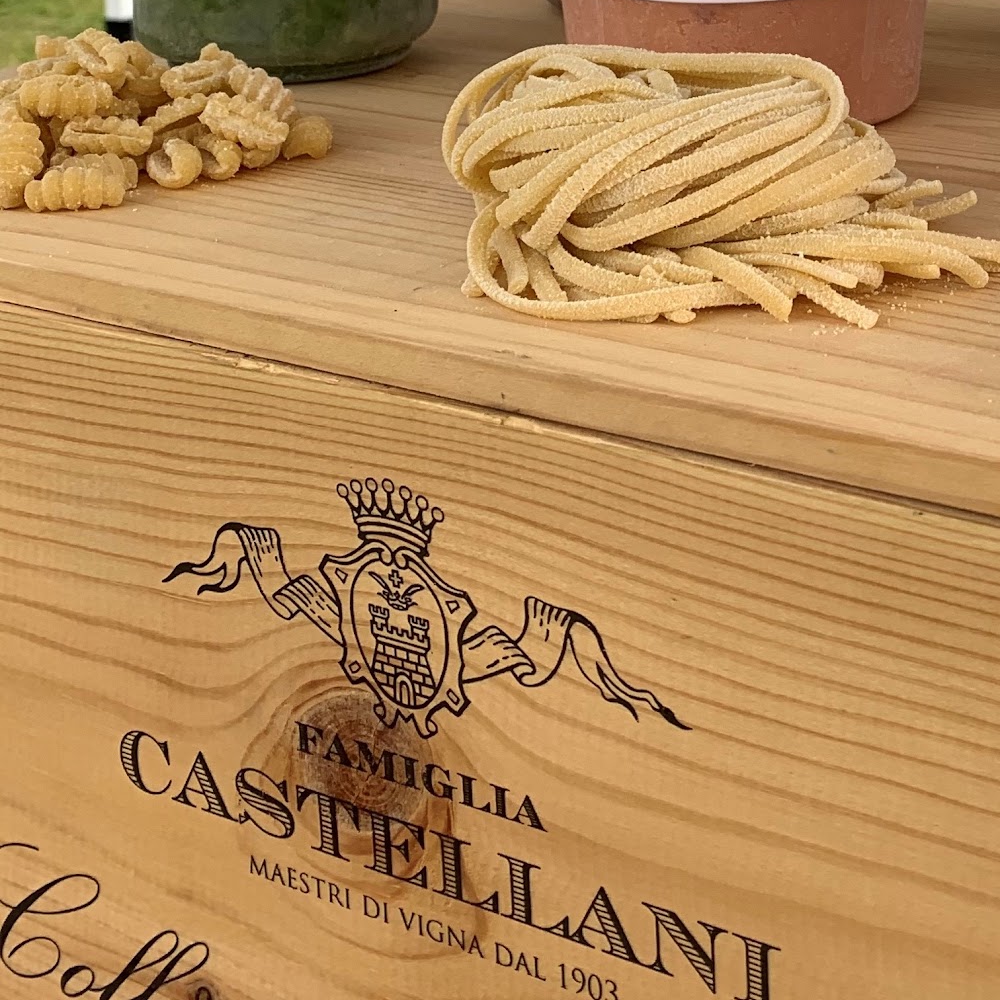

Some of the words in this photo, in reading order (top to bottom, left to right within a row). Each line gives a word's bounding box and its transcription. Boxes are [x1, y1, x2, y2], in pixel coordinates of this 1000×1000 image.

[295, 720, 548, 833] FAMIGLIA
[119, 730, 781, 1000] CASTELLANI
[249, 855, 351, 910] MAESTRI
[362, 894, 389, 924] DI
[399, 907, 484, 959] VIGNA
[494, 942, 547, 982] DAL
[558, 963, 618, 1000] 1903
